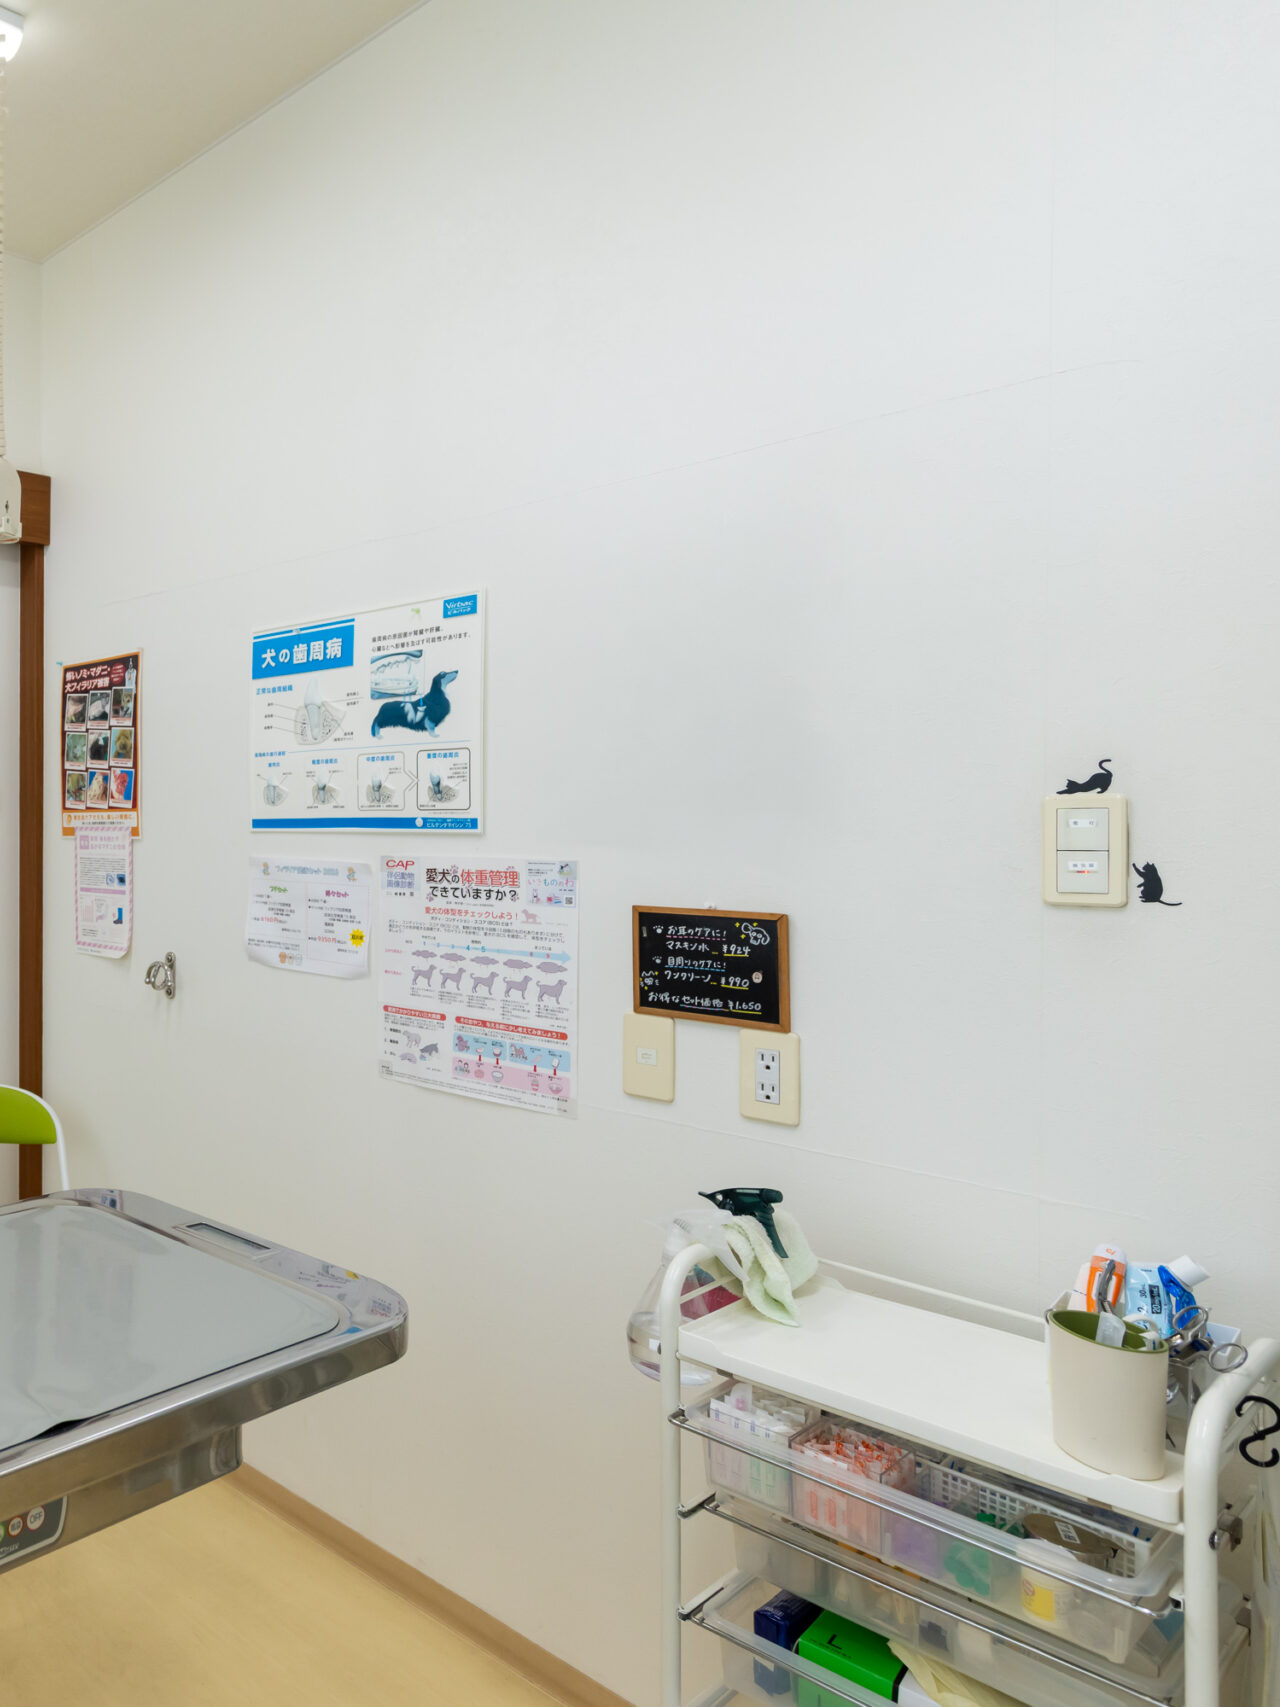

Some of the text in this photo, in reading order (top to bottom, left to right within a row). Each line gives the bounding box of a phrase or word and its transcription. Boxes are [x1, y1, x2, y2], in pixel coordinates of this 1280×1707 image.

[261, 637, 343, 669] 犬の歯周病
[386, 859, 415, 871] CAP
[426, 868, 519, 887] 愛犬の体重管理
[666, 941, 751, 956] マスキン水 ¥924
[721, 977, 750, 987] ¥990
[29, 1511, 43, 1524] OFF
[827, 1633, 842, 1650] L
